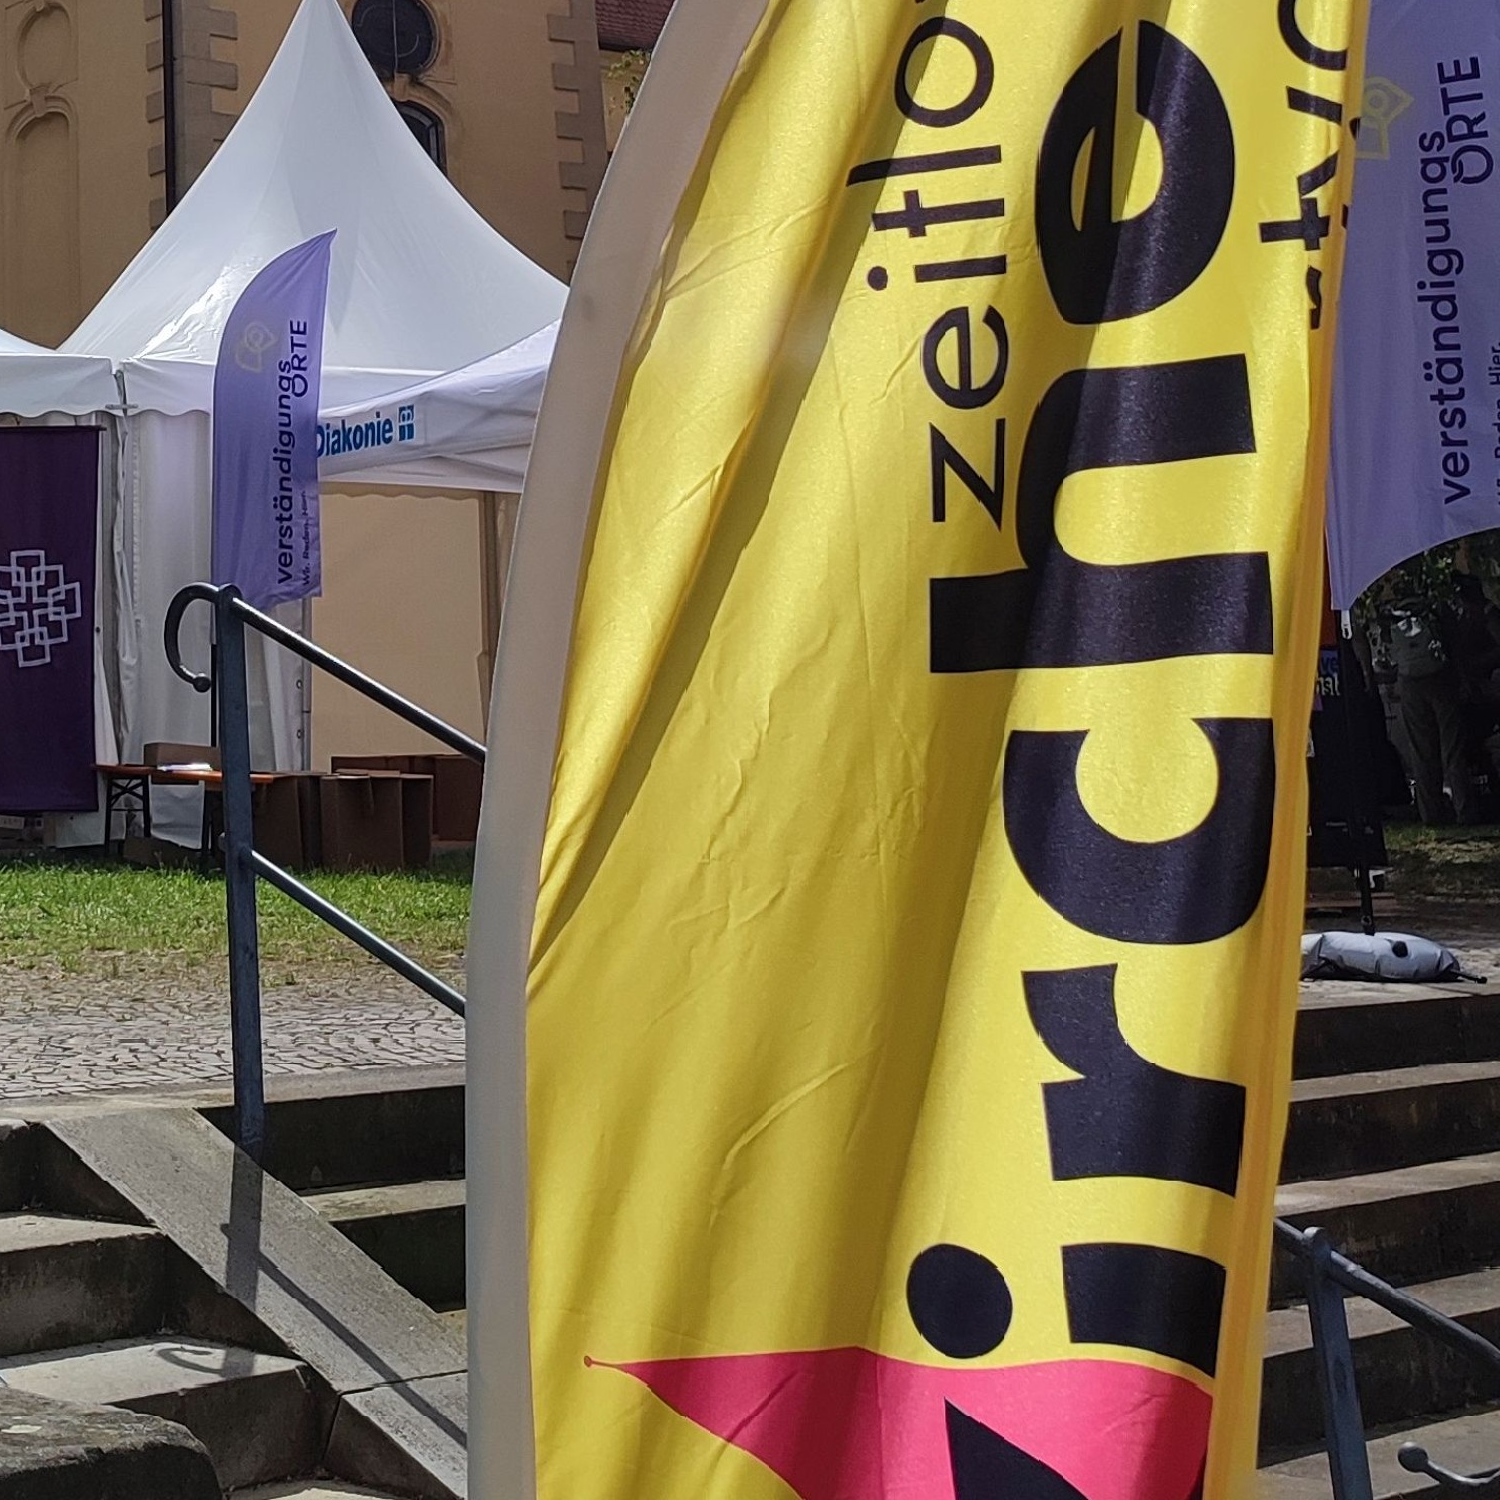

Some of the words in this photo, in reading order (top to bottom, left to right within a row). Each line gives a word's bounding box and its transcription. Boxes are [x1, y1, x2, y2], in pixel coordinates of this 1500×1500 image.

[1436, 56, 1494, 184] ORTE
[289, 319, 308, 398] ORTE
[1417, 130, 1472, 505] verständigungs
[273, 359, 296, 585] verständigungs
[316, 411, 394, 458] Diakonie
